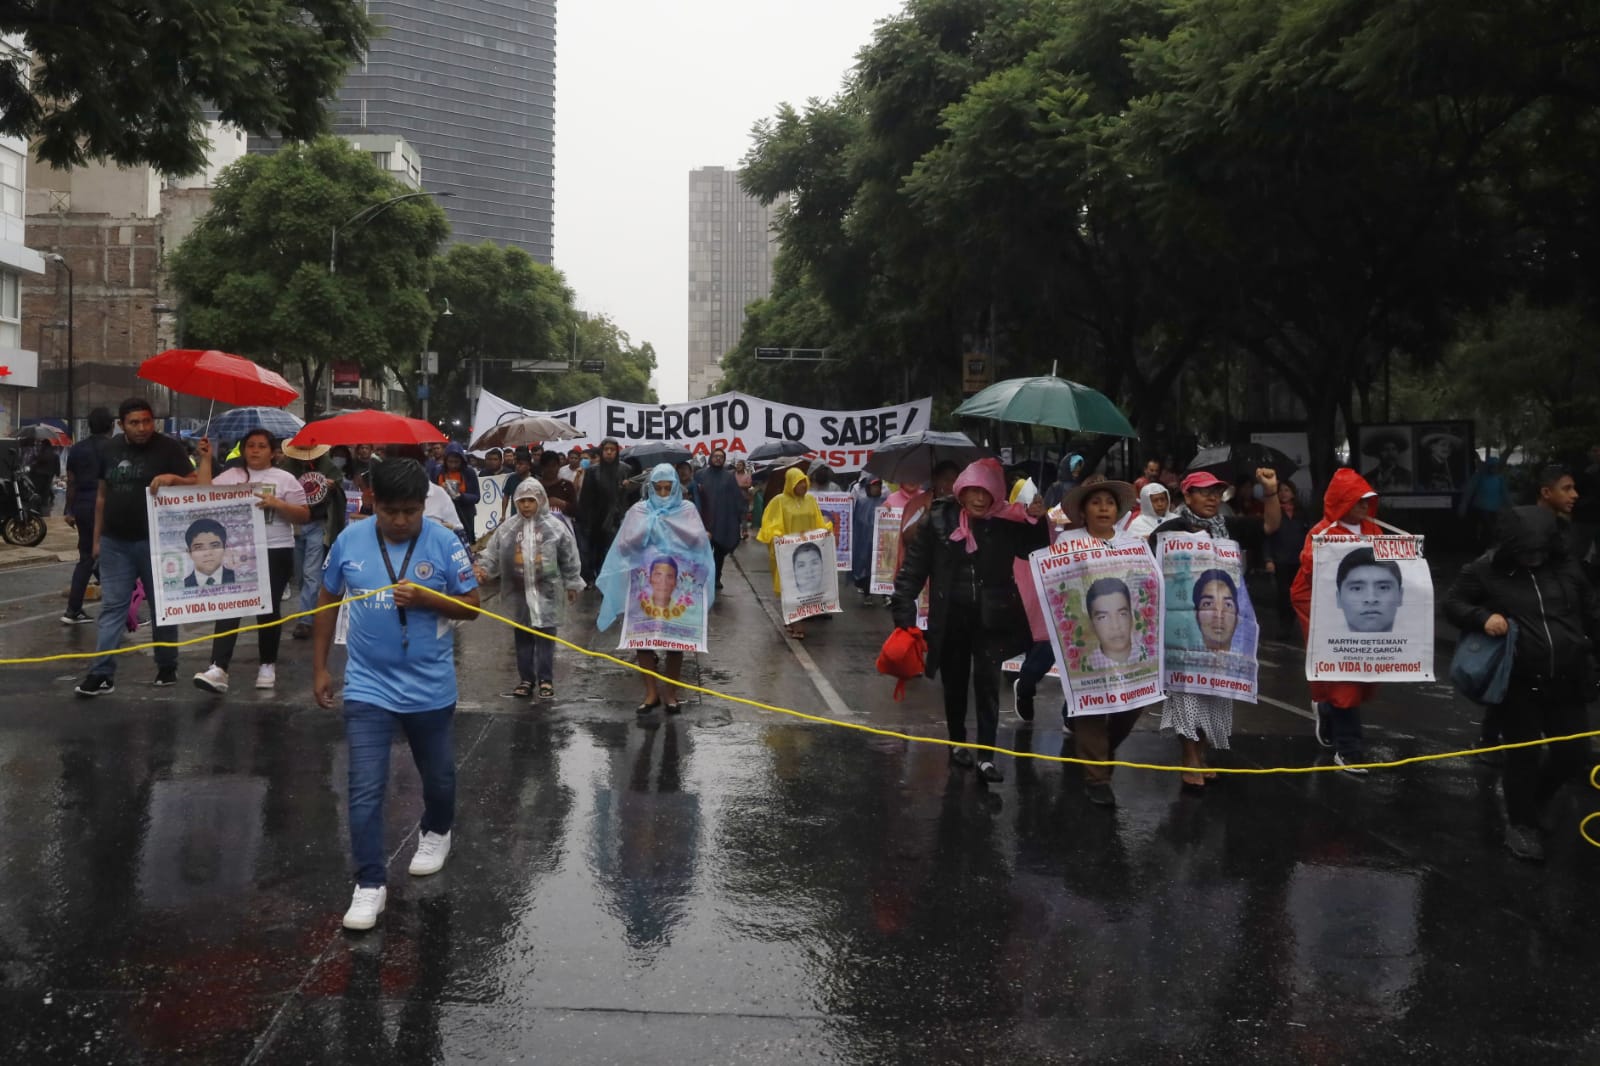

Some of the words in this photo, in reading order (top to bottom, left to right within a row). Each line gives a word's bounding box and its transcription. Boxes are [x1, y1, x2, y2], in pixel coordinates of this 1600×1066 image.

[765, 407, 805, 441] LO
[154, 495, 180, 507] ¡Vivo
[183, 495, 194, 504] se
[196, 493, 207, 502] lo
[209, 488, 253, 501] llevaron!
[1164, 540, 1194, 554] ¡Vivo
[1197, 542, 1211, 550] se
[1373, 540, 1389, 559] NOS
[1389, 540, 1416, 558] FALTAN
[1073, 552, 1088, 562] se
[165, 606, 184, 618] ¡Con
[185, 602, 207, 615] VIDA
[208, 601, 216, 612] lo
[218, 596, 261, 610] queremos!
[1315, 661, 1336, 674] ¡Con
[1338, 661, 1361, 673] VIDA
[1363, 661, 1373, 673] lo
[1374, 661, 1421, 675] queremos!
[1169, 671, 1194, 685] ¡Vivo
[1197, 674, 1207, 685] lo
[1209, 678, 1253, 693] queremos!
[1079, 693, 1105, 710] ¡Vivo
[1105, 691, 1117, 704] lo
[1120, 681, 1156, 704] queremos!
